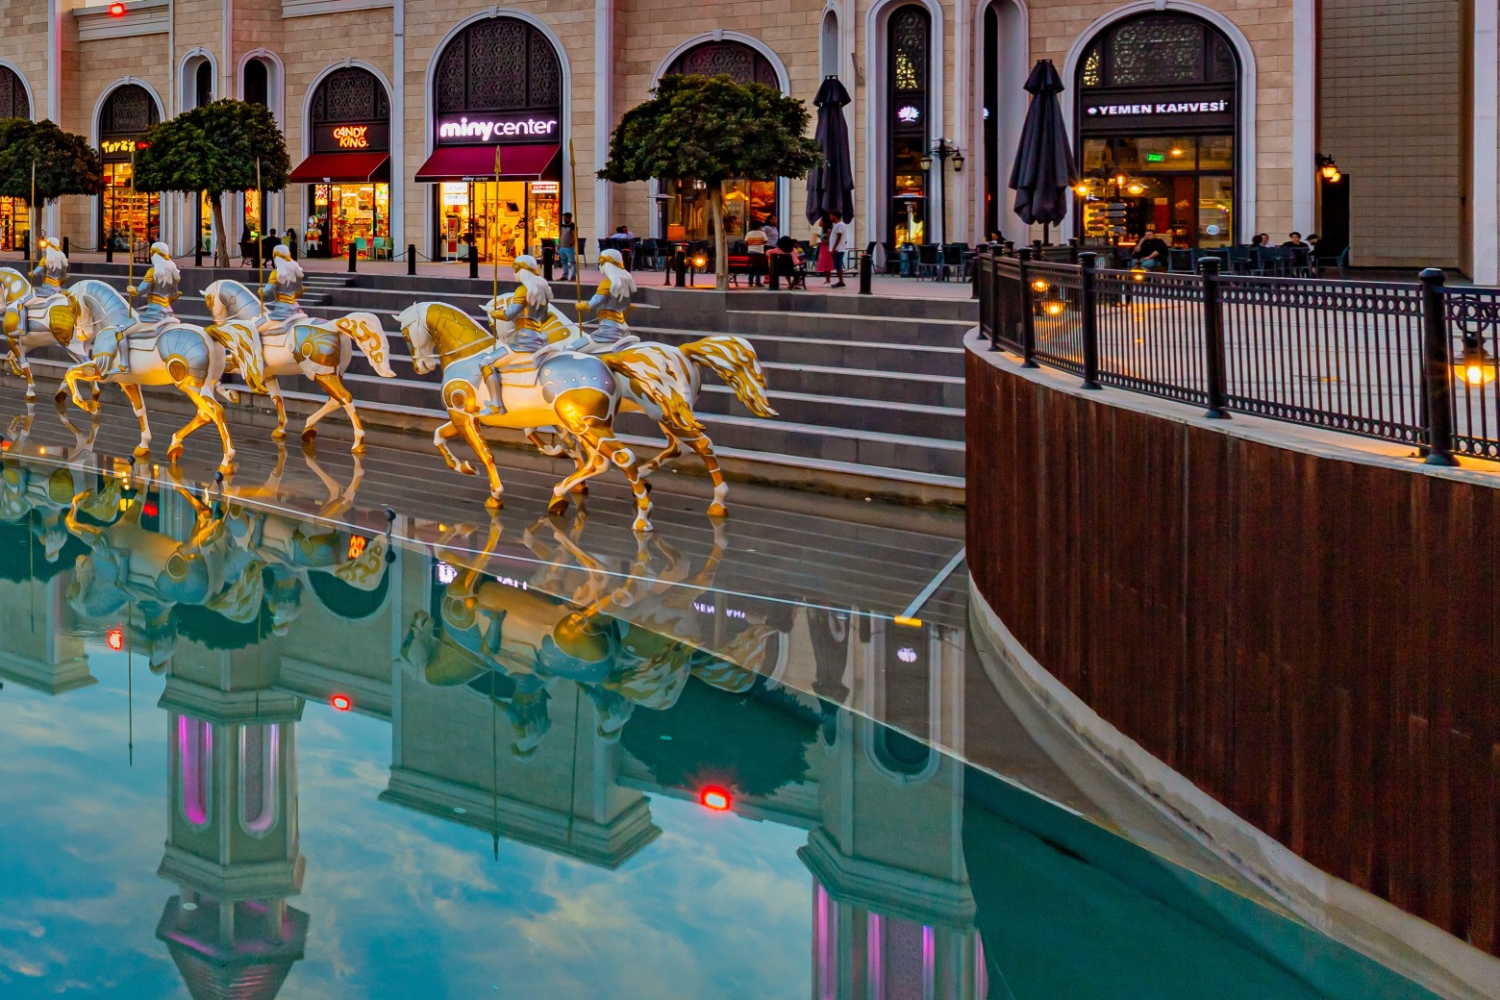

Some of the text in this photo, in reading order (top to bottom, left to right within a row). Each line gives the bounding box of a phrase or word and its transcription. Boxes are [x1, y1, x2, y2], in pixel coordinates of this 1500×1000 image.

[1099, 100, 1225, 115] YEMEN KAHVESİ
[333, 126, 368, 139] CANDY
[439, 117, 557, 141] miny center
[340, 136, 367, 148] KING
